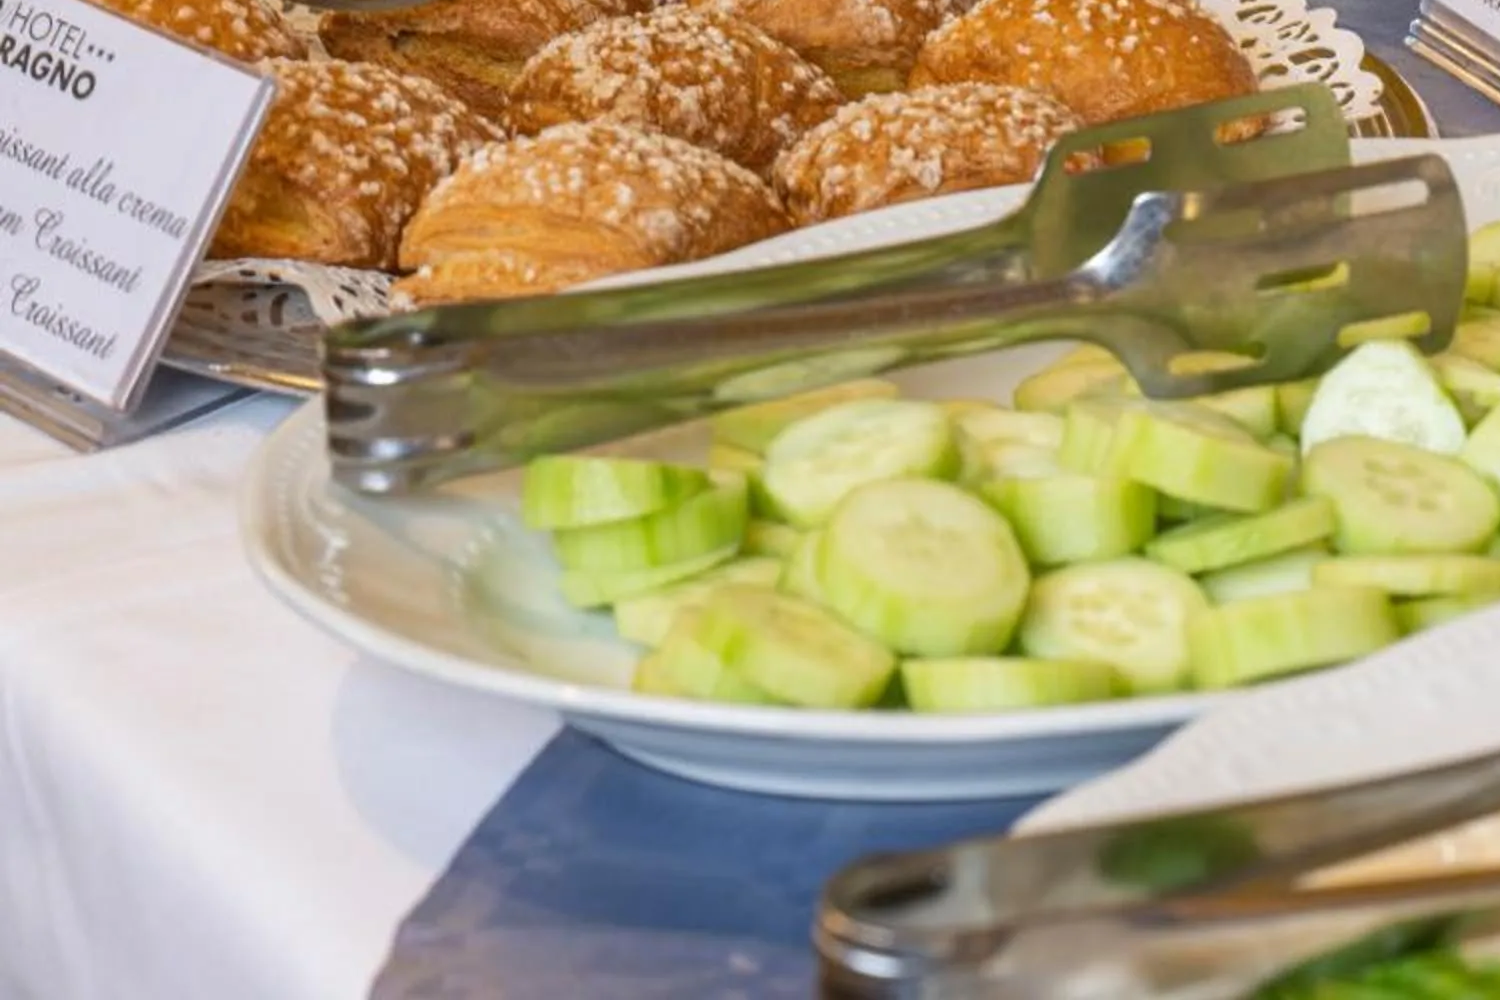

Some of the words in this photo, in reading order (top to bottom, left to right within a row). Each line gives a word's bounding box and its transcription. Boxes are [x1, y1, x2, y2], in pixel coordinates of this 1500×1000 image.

[0, 34, 97, 101] RAGNO
[65, 156, 117, 205] alla
[117, 191, 188, 239] crema
[34, 207, 143, 293] Croissant
[10, 273, 119, 359] Croissant
